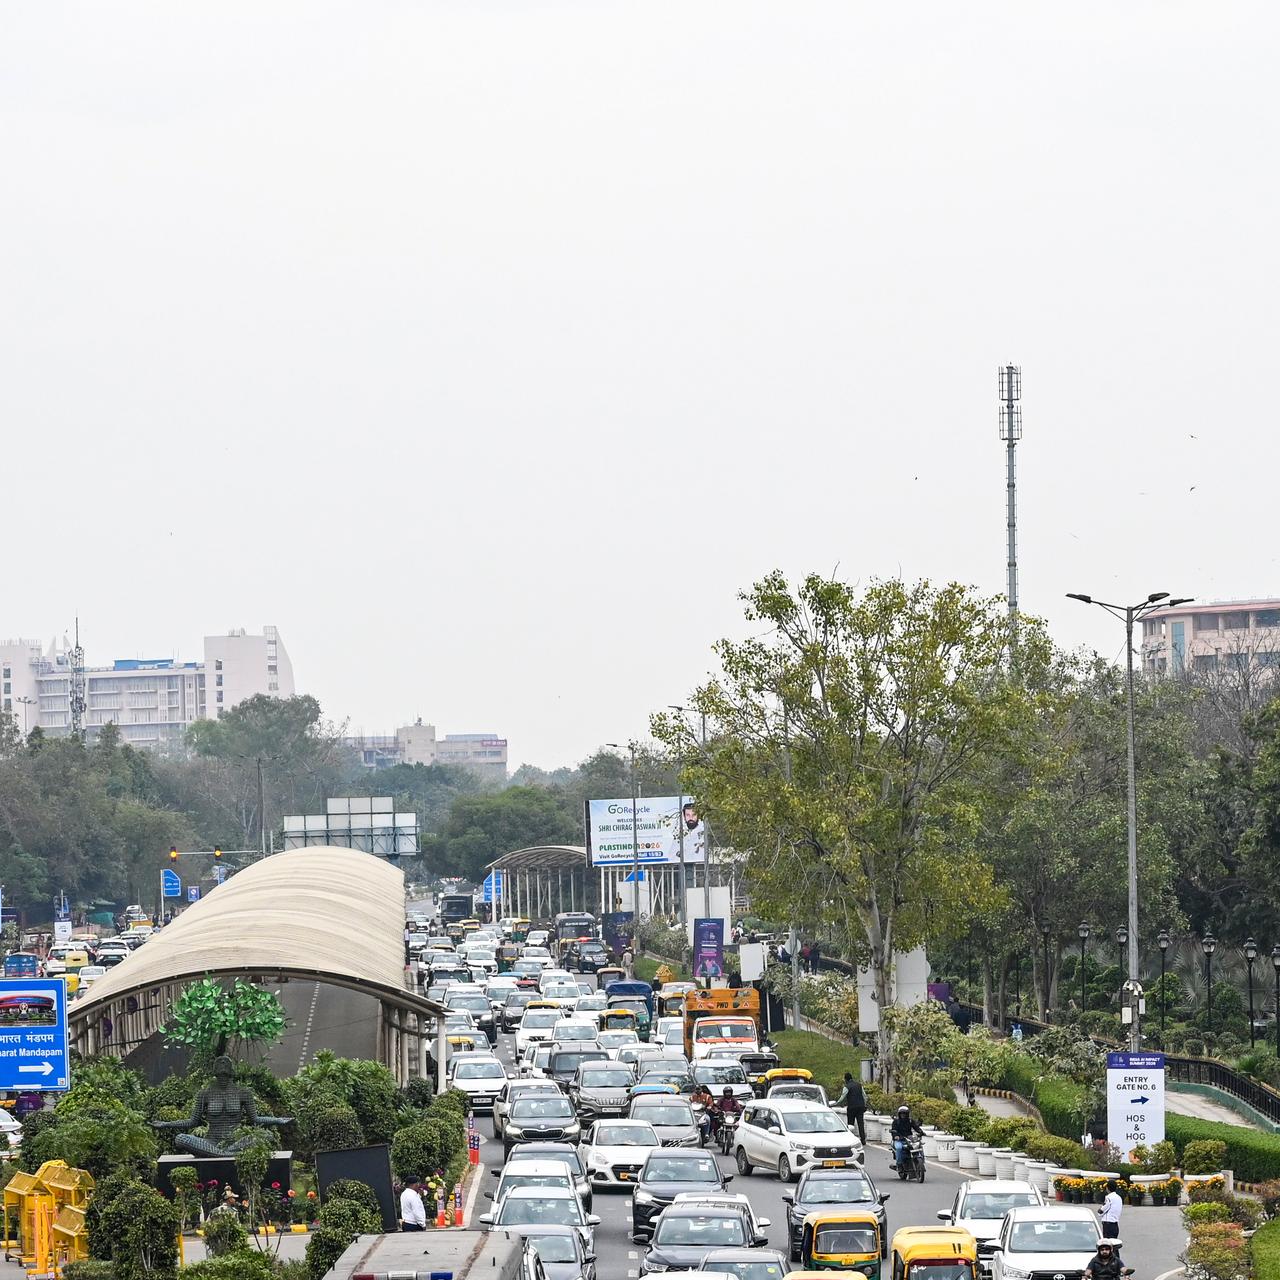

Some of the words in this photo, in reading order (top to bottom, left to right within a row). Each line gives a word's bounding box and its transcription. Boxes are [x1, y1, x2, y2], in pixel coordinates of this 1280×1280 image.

[612, 823, 633, 831] CHIRAG
[634, 823, 656, 831] ASWAN
[25, 1031, 55, 1044] मंडपम
[18, 1048, 63, 1058] Mandapam
[1116, 1083, 1136, 1091] GATE
[1137, 1083, 1150, 1091] NO.
[1151, 1083, 1157, 1091] 6
[1126, 1114, 1146, 1123] HOS
[1133, 1123, 1140, 1132] &
[1125, 1132, 1146, 1141] HOG
